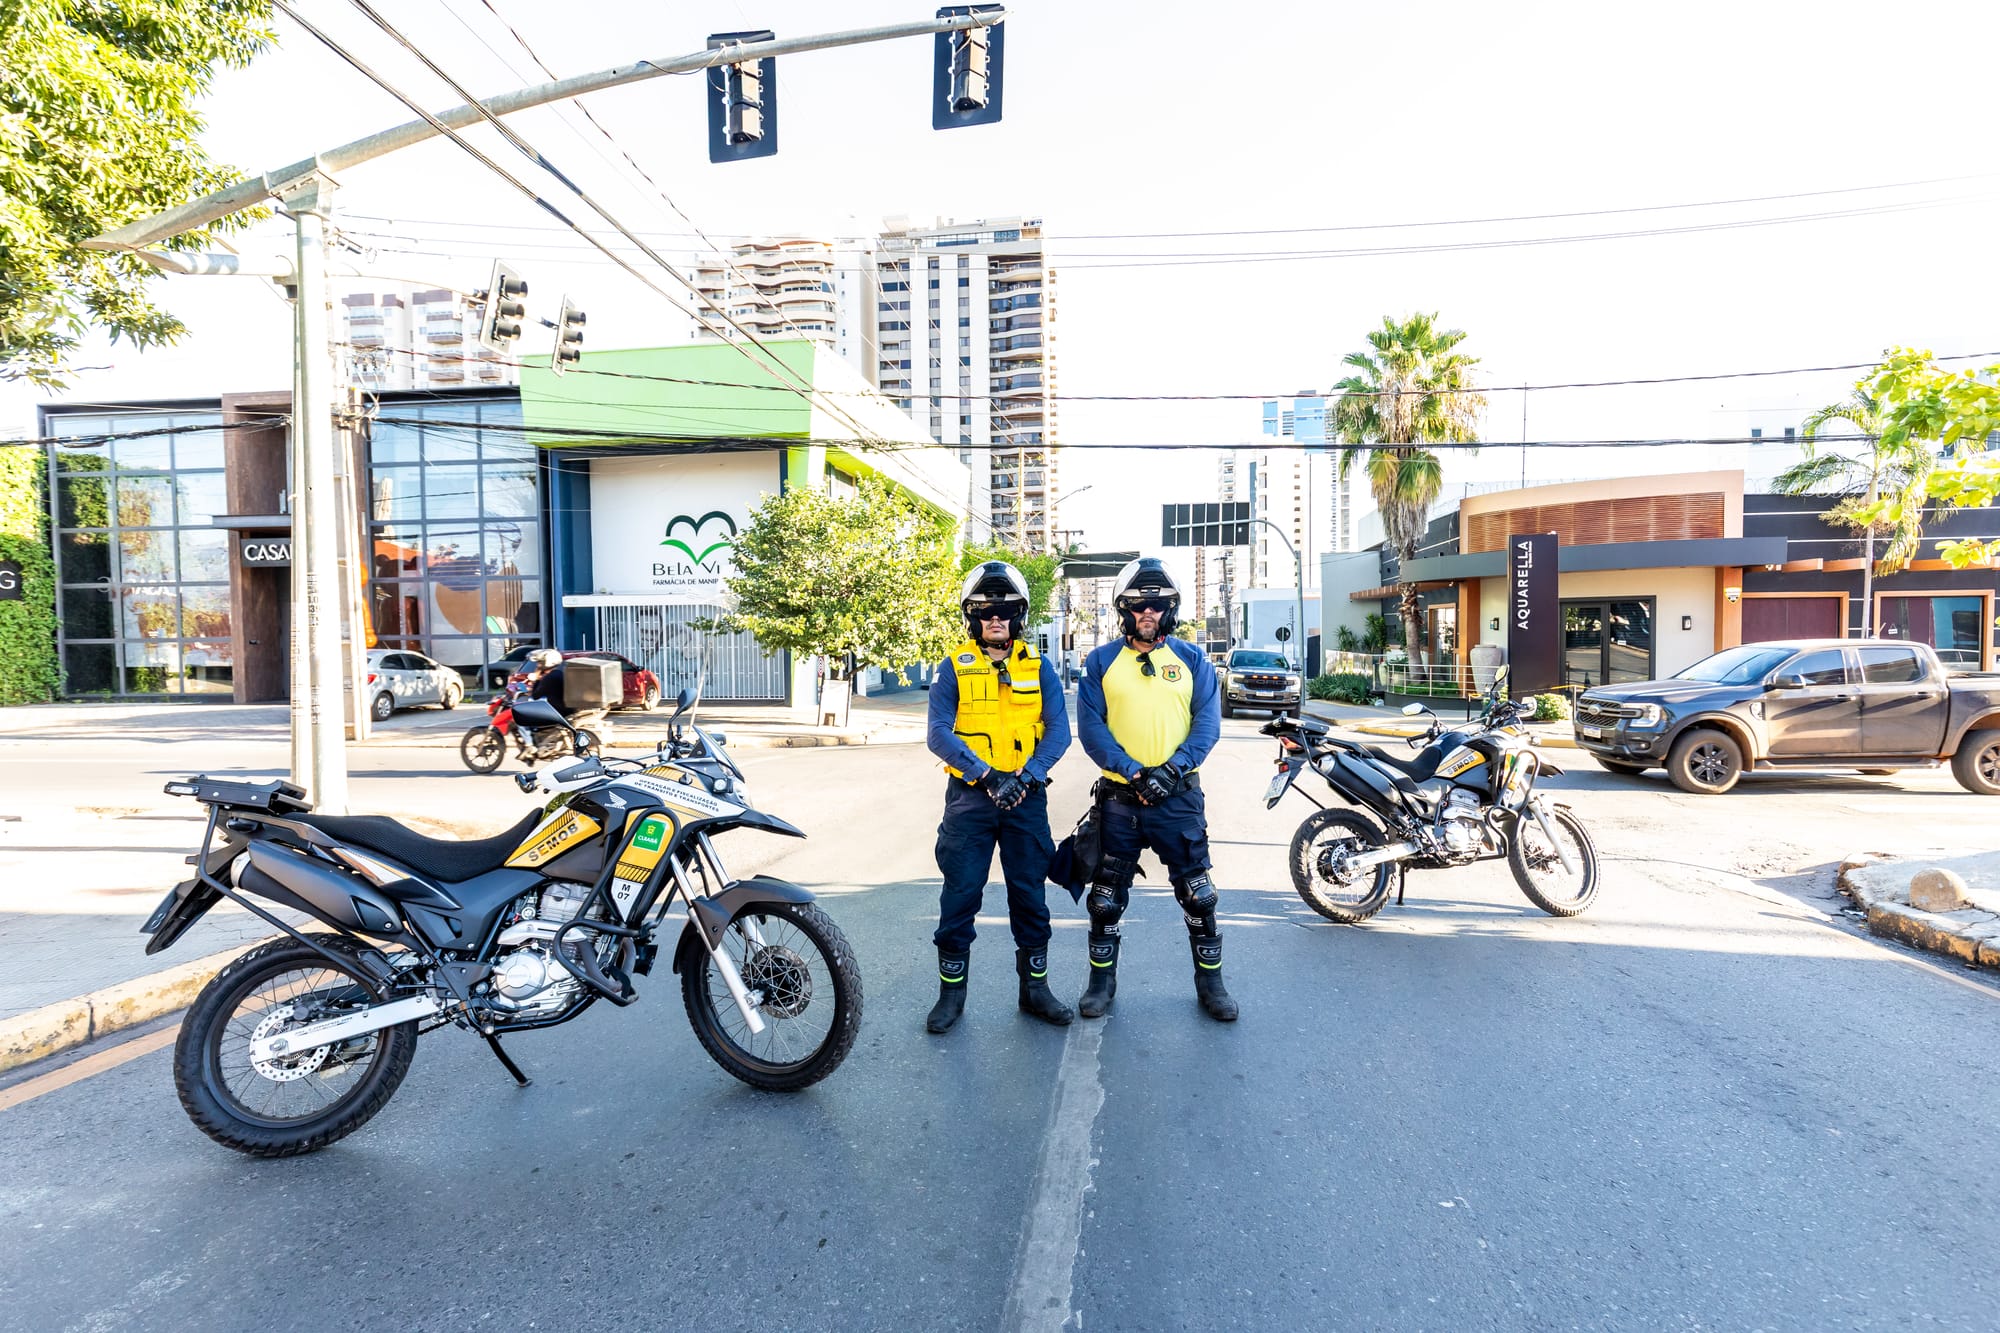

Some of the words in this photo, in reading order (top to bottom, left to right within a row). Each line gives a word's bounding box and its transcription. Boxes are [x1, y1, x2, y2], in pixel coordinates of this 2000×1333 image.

[0, 570, 16, 590] G
[652, 577, 686, 585] FARMÁCIA
[1517, 541, 1531, 630] AQUARELLA
[1447, 755, 1475, 775] SEMOB
[638, 779, 671, 791] OPERAÇÃO
[676, 789, 718, 807] FISCALIZAÇÃO
[643, 783, 673, 797] TRÂNSITO
[679, 795, 719, 812] TRANSPORTES
[528, 822, 579, 862] SEMOB
[617, 892, 630, 901] 07
[621, 883, 631, 891] M
